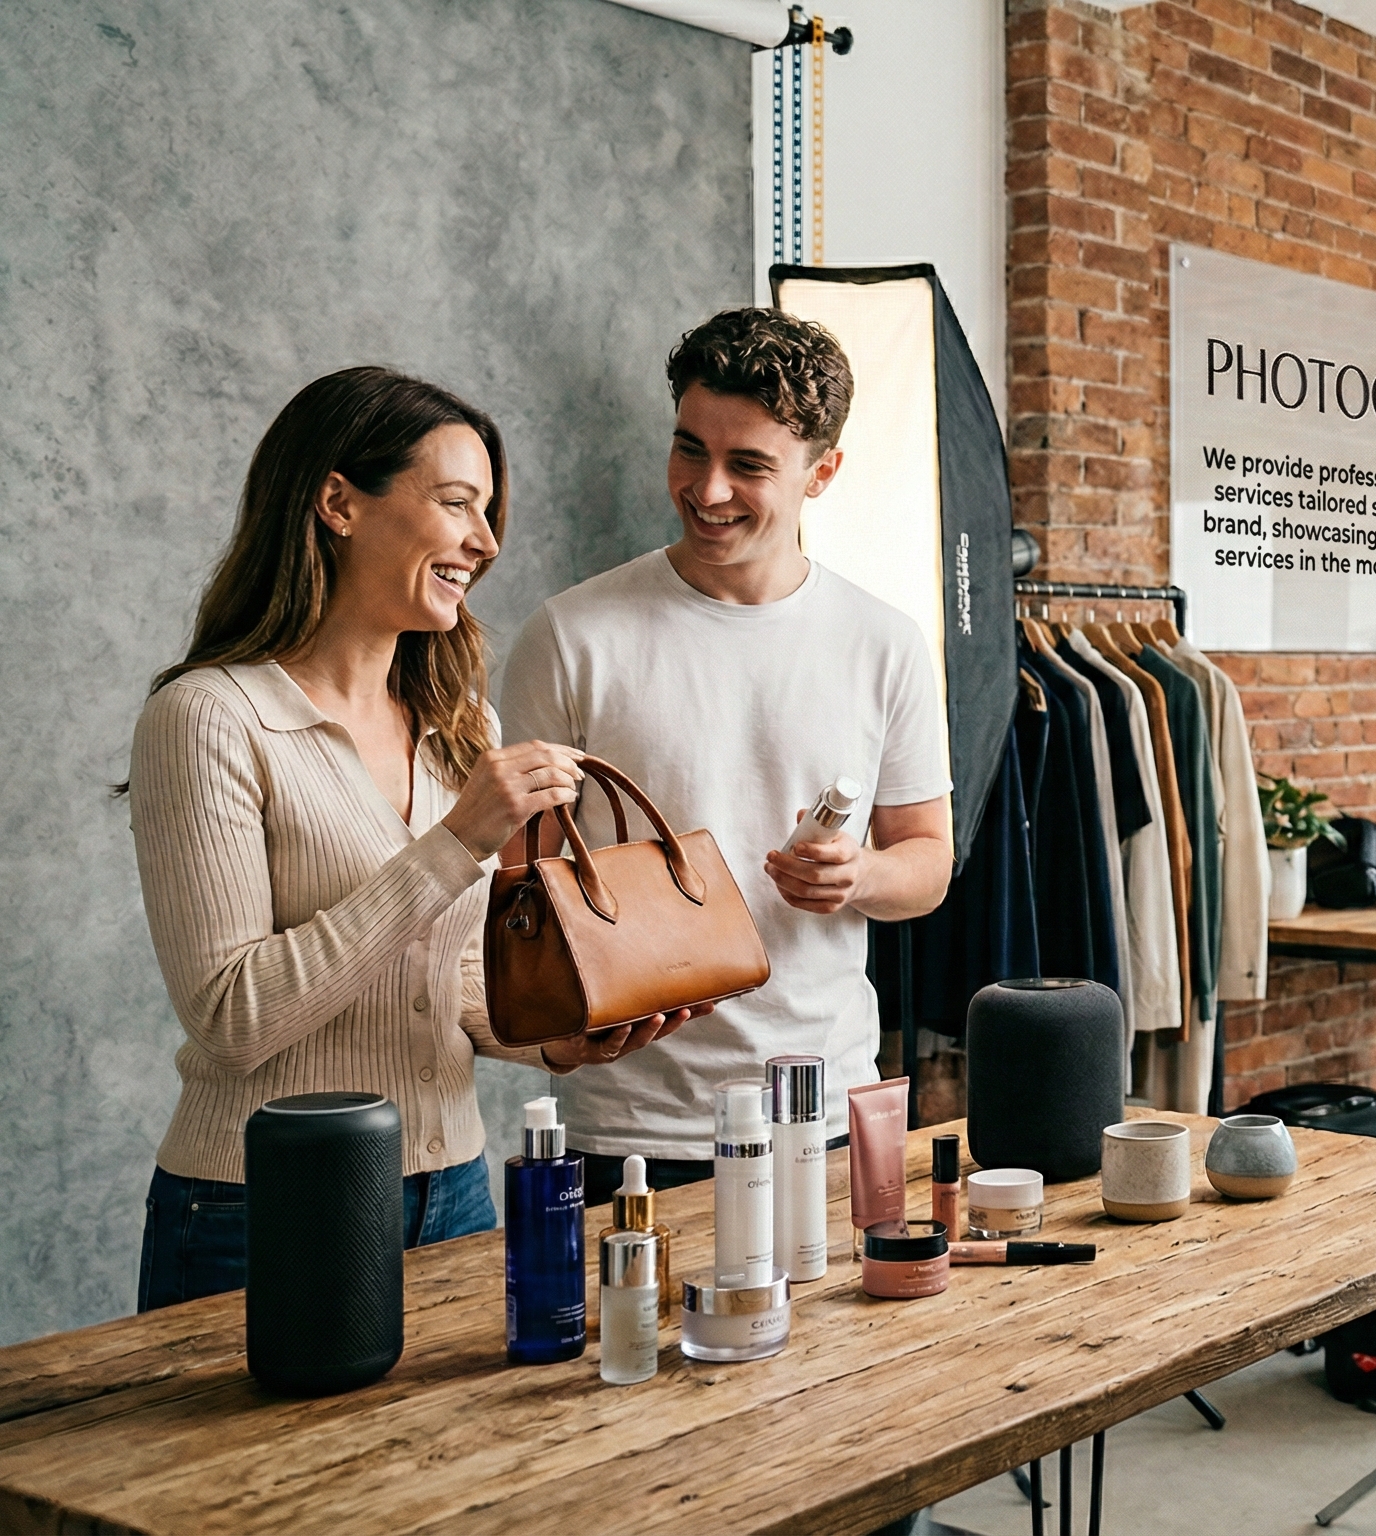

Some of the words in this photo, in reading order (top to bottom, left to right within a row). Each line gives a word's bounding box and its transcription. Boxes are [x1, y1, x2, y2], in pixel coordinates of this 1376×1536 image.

[1202, 445, 1237, 471] We
[1242, 454, 1314, 480] provide
[1214, 482, 1294, 509] services
[1297, 488, 1367, 516] tailored
[1203, 509, 1267, 541] brand,
[1214, 545, 1295, 570] services
[1299, 548, 1316, 572] in
[1320, 551, 1351, 574] the
